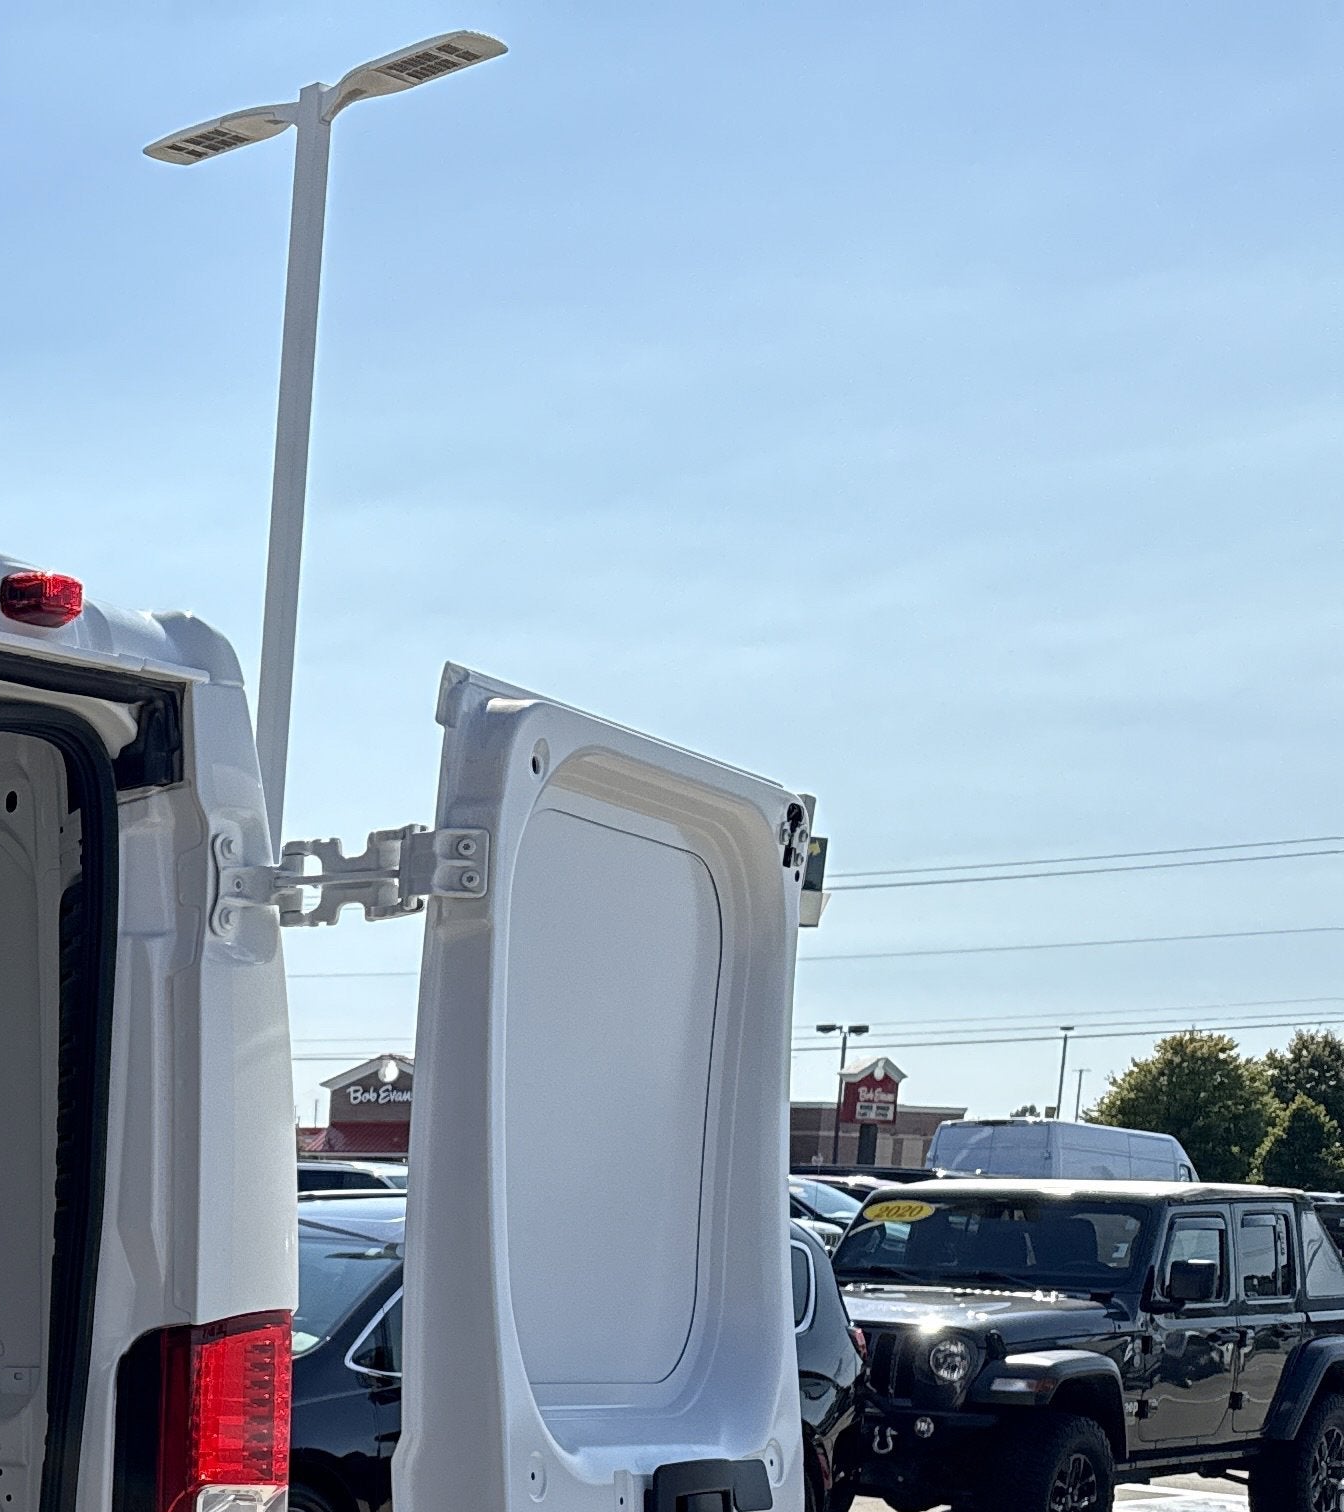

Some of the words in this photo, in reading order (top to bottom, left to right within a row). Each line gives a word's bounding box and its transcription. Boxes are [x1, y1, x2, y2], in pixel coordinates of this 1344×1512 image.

[346, 1085, 377, 1104] Bob
[377, 1084, 412, 1104] Evan
[874, 1205, 924, 1218] 2020
